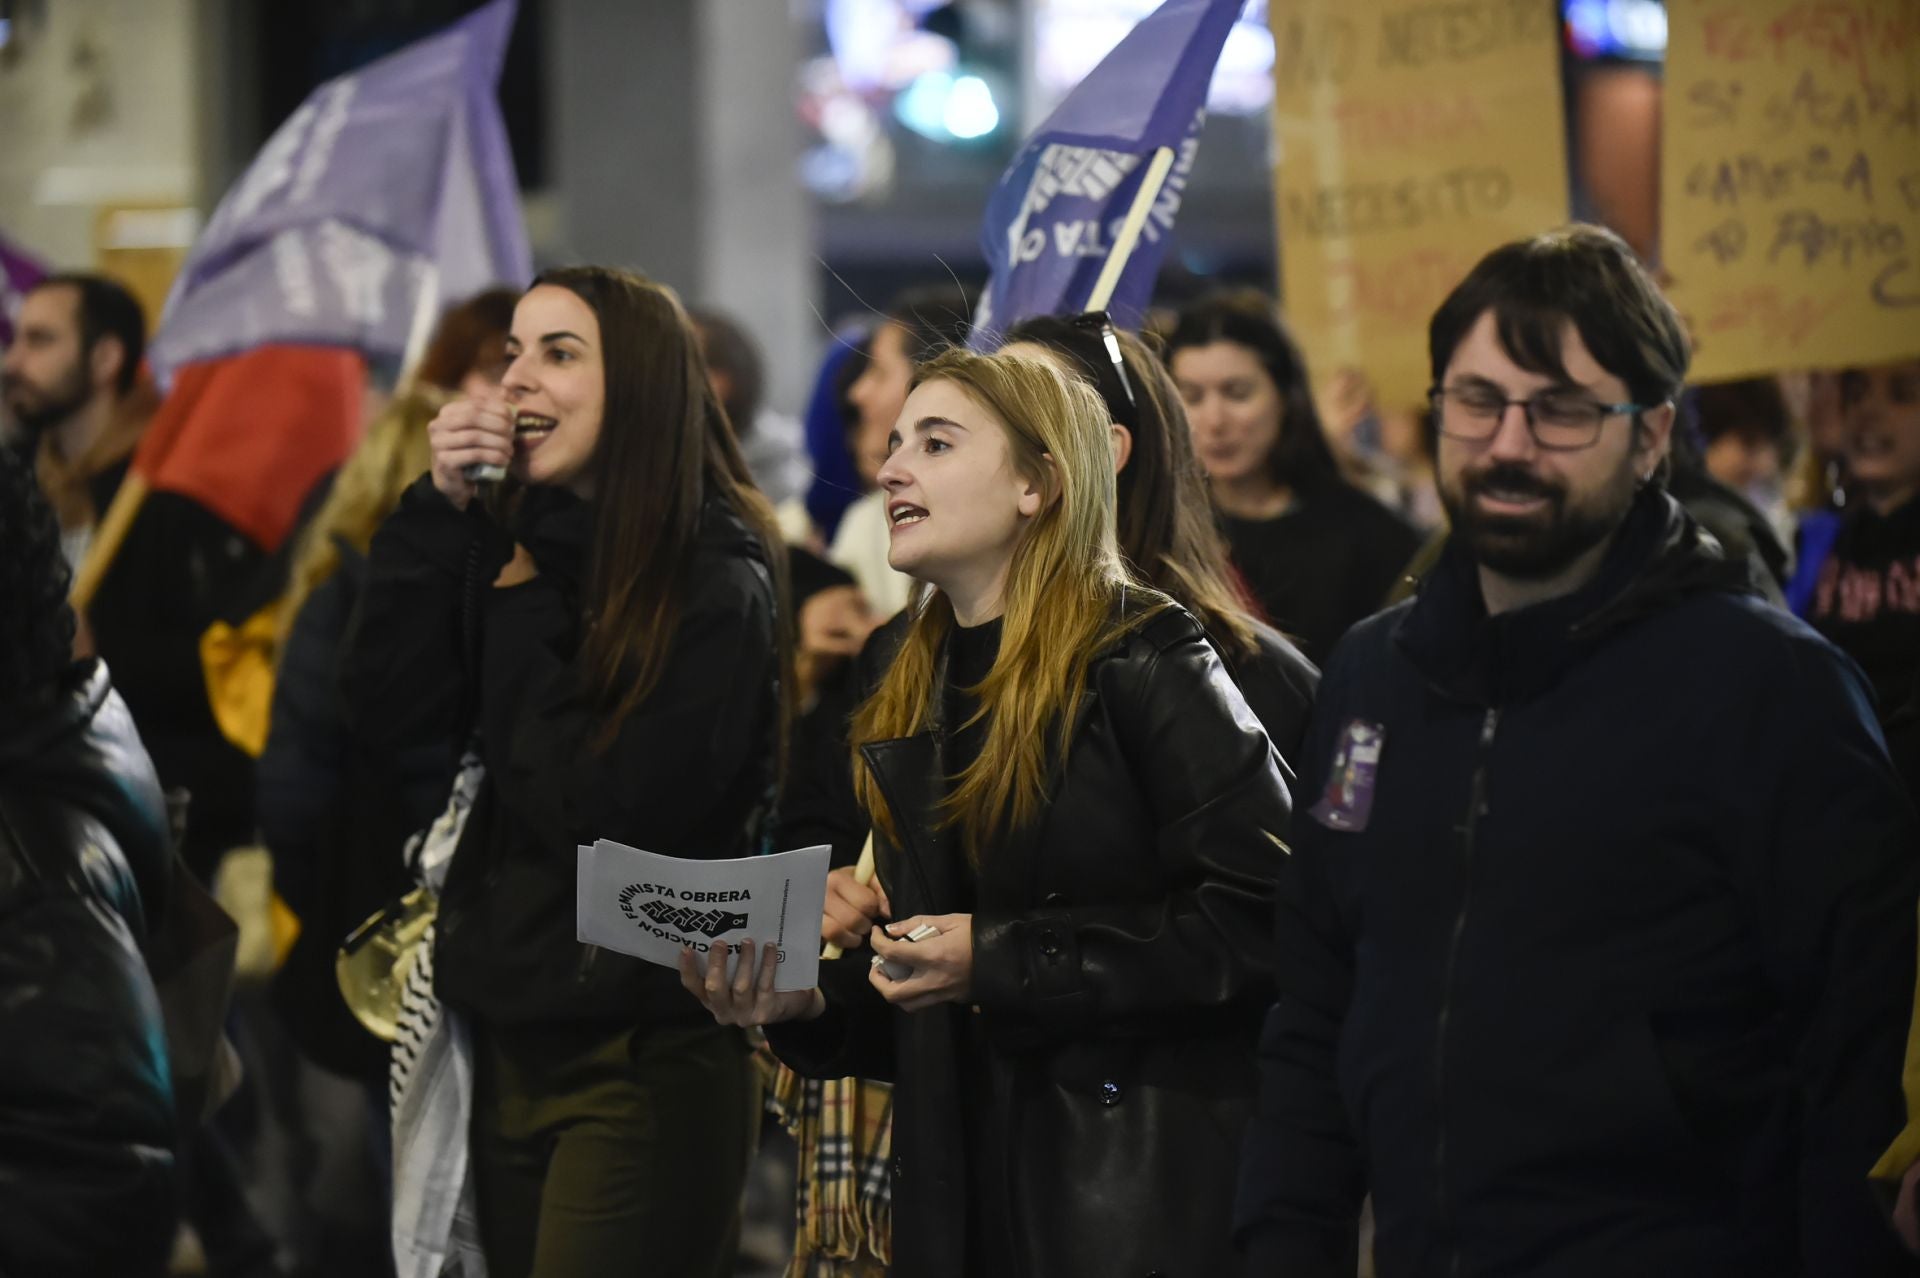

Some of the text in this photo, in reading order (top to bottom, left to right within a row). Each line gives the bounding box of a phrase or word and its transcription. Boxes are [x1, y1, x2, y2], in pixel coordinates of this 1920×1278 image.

[618, 883, 752, 920] FEMINISTA OBRERA
[638, 920, 742, 956] ASCIACIÓN
